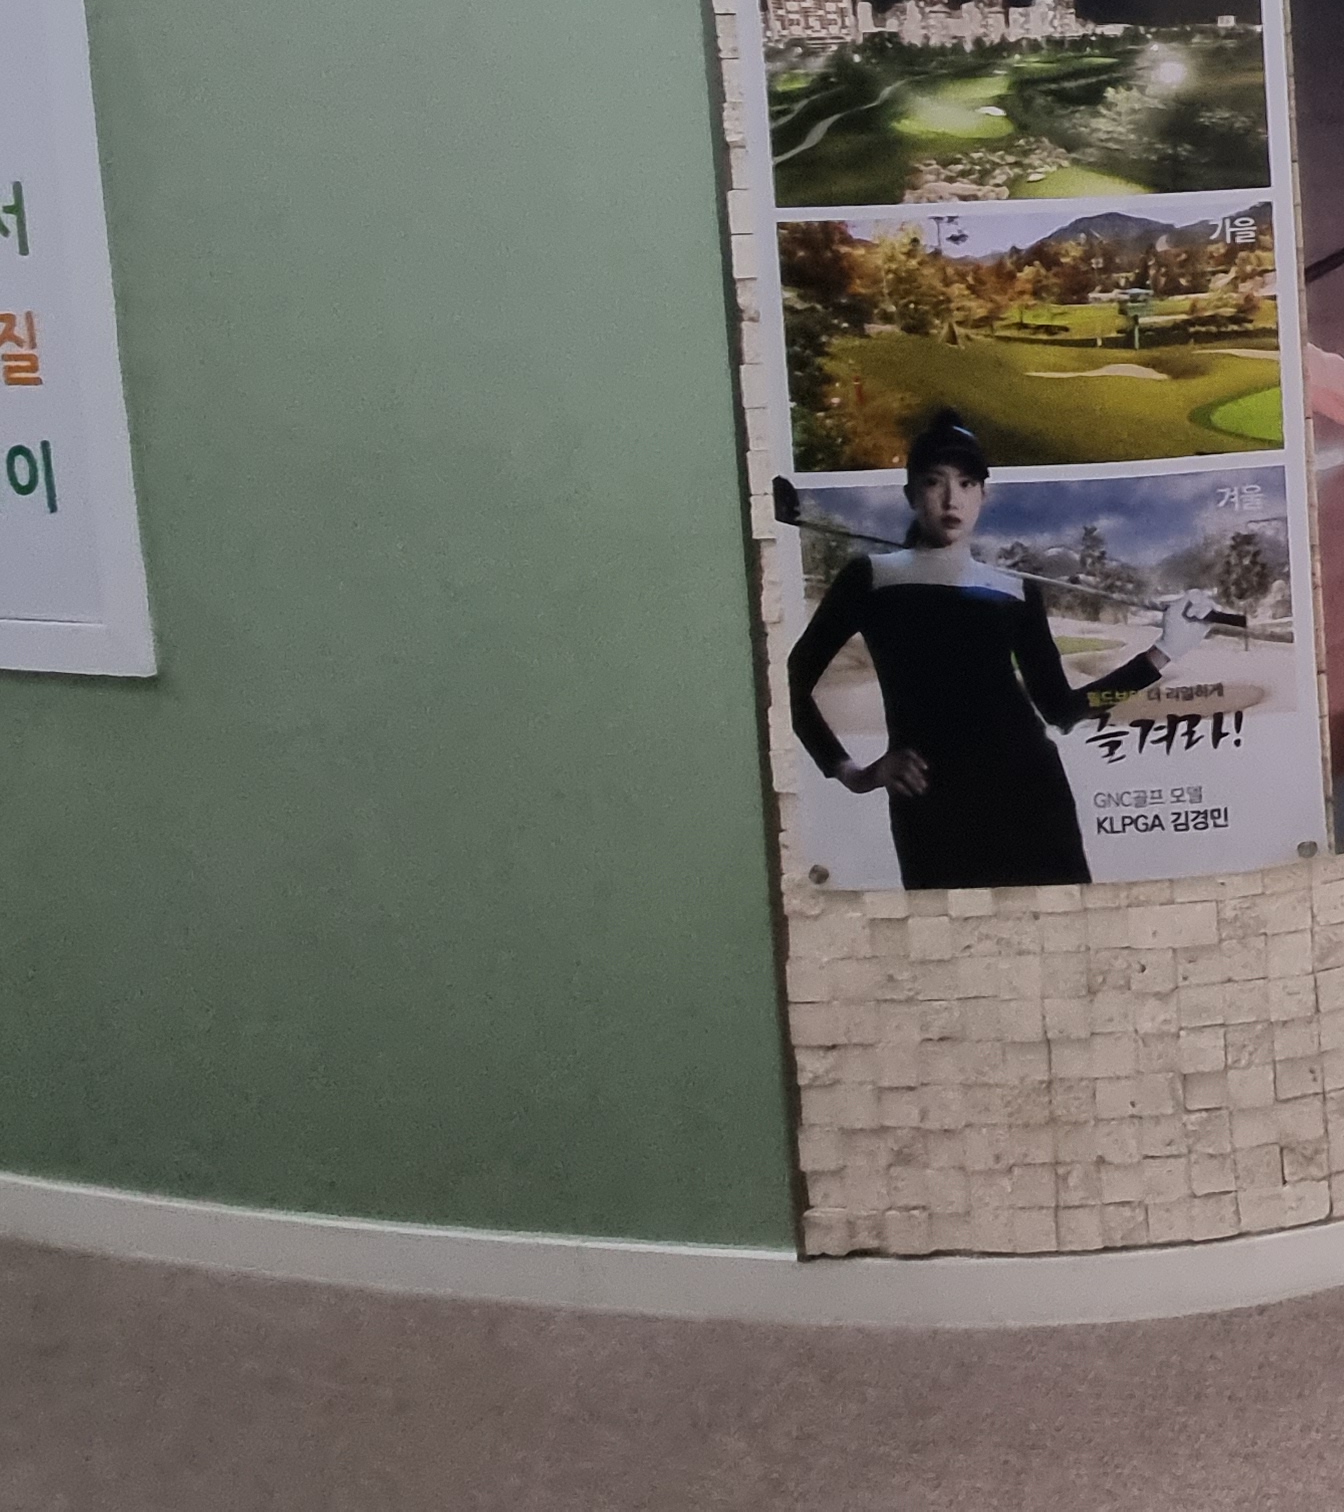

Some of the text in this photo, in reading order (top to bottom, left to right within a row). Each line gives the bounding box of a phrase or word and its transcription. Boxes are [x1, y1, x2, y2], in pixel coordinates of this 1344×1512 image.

[1209, 216, 1258, 245] 가을
[1216, 484, 1264, 511] 겨울
[1093, 785, 1203, 809] GNC골프 모델
[1096, 806, 1229, 835] KLPGA 김경민
